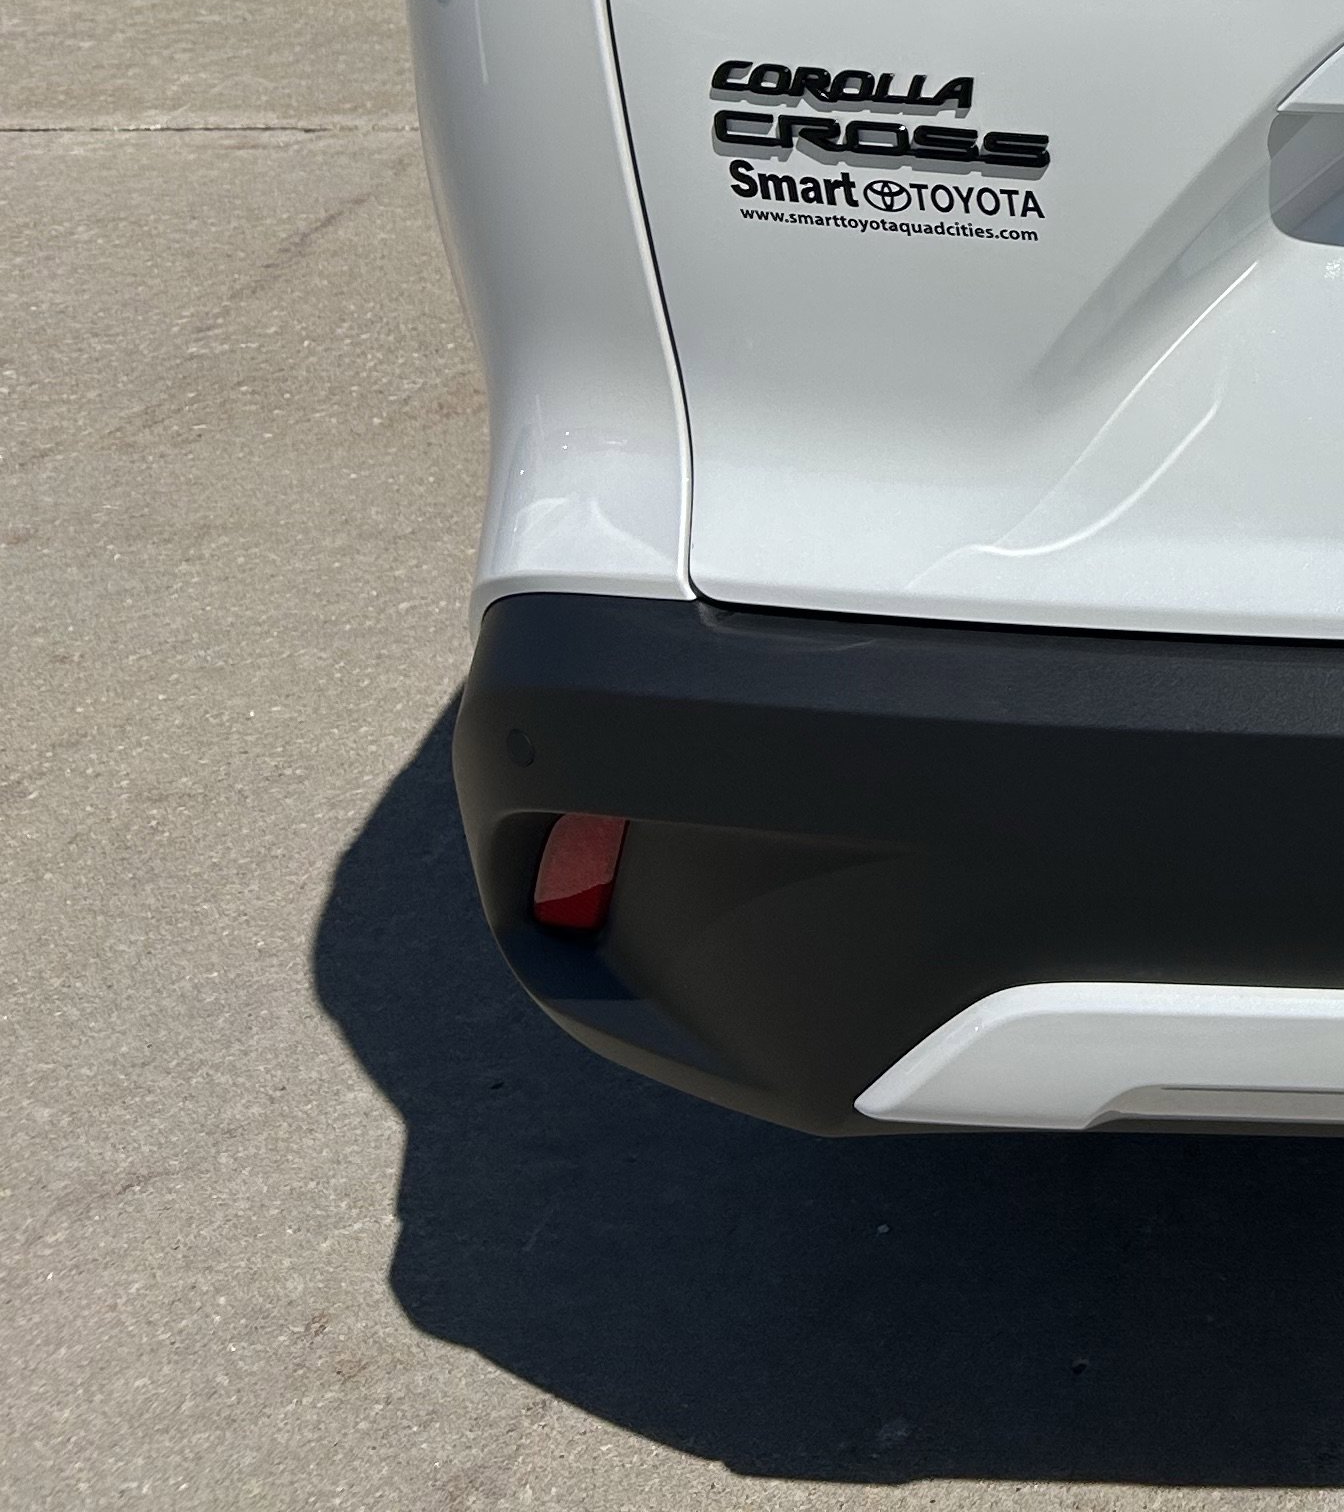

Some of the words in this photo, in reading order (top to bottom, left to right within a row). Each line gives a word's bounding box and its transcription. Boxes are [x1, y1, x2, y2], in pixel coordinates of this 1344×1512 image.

[711, 60, 975, 109] COROLLA
[713, 109, 1051, 168] CROSS
[728, 158, 860, 209] Smart
[908, 182, 1046, 219] TOYOTA
[739, 206, 1039, 242] www.smarttoyotaquadcities.com
